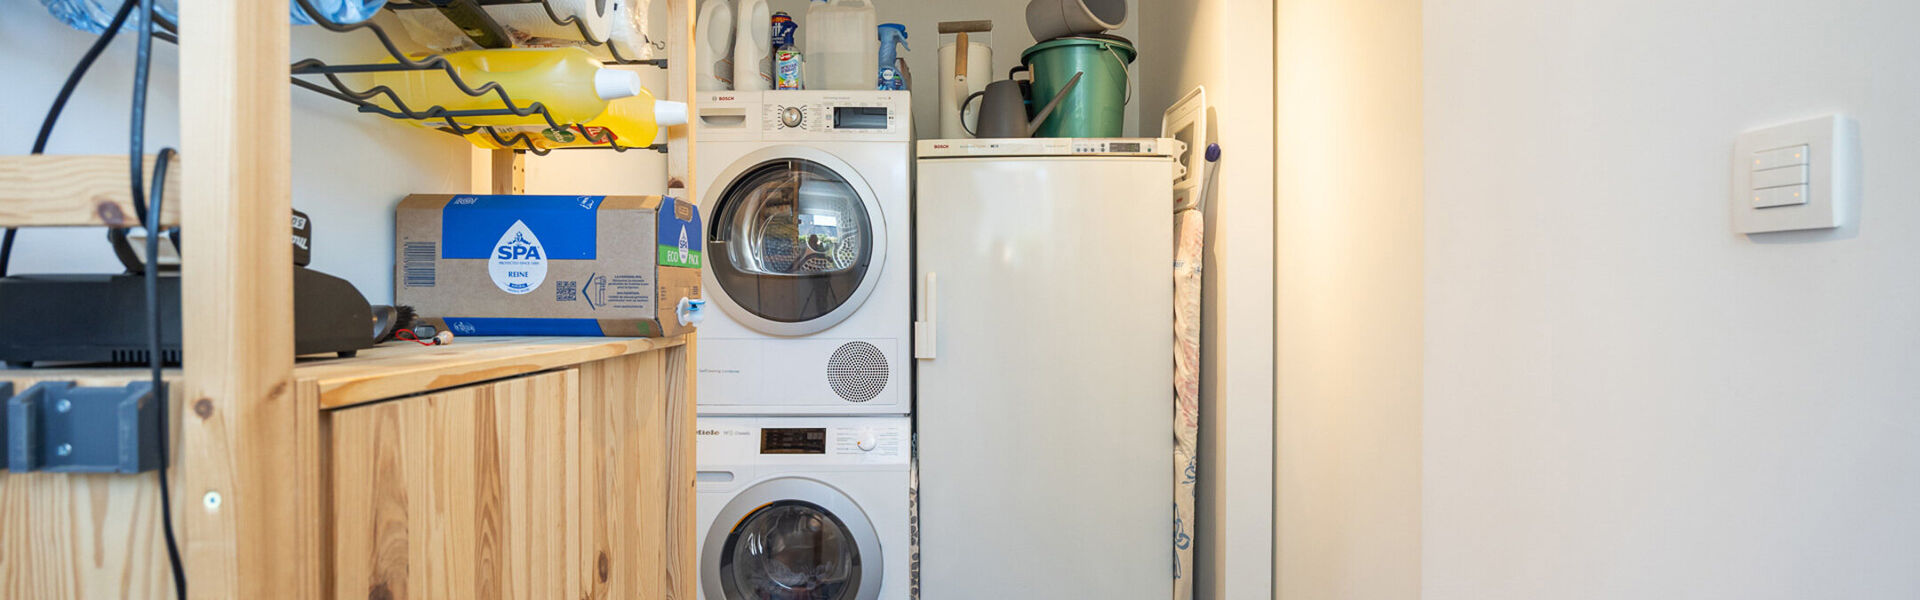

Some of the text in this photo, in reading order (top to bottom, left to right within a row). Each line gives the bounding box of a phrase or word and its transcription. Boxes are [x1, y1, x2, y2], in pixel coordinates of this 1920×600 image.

[497, 245, 541, 260] SPA
[667, 251, 699, 265] ECO PACK
